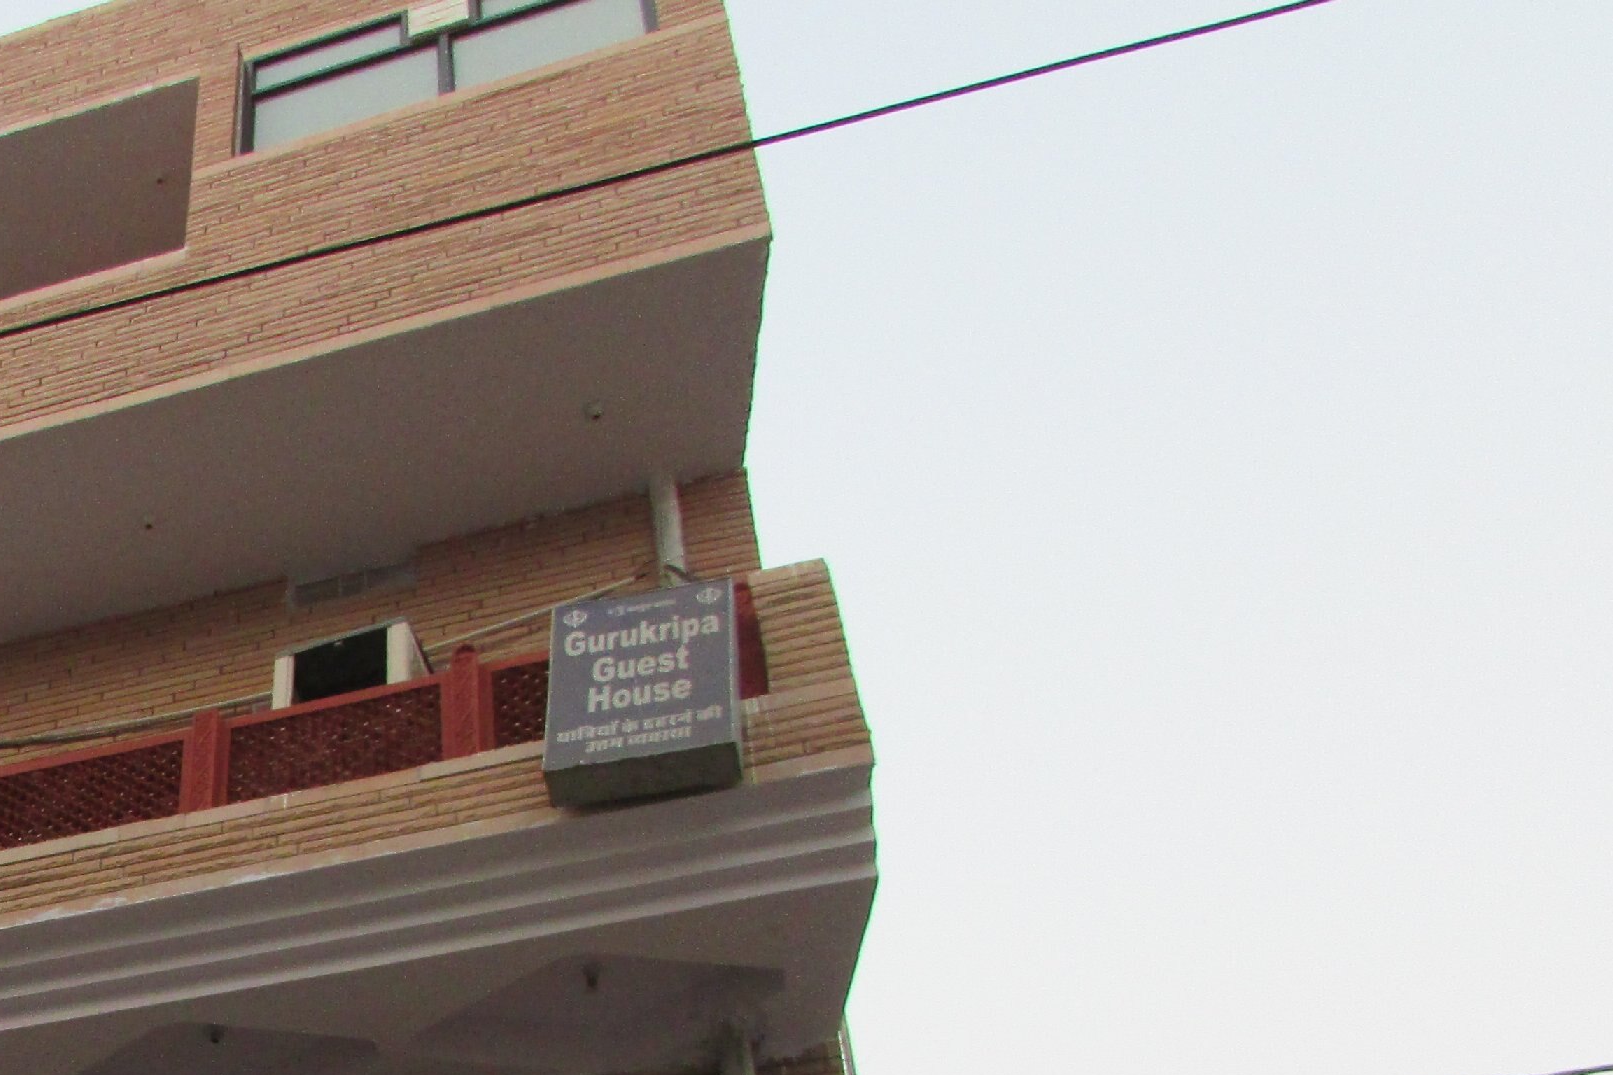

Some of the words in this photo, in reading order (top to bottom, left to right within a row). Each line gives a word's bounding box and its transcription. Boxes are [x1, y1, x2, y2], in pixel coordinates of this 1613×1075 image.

[564, 615, 720, 657] Gurukripa
[592, 644, 690, 682] Guest
[588, 678, 692, 713] House
